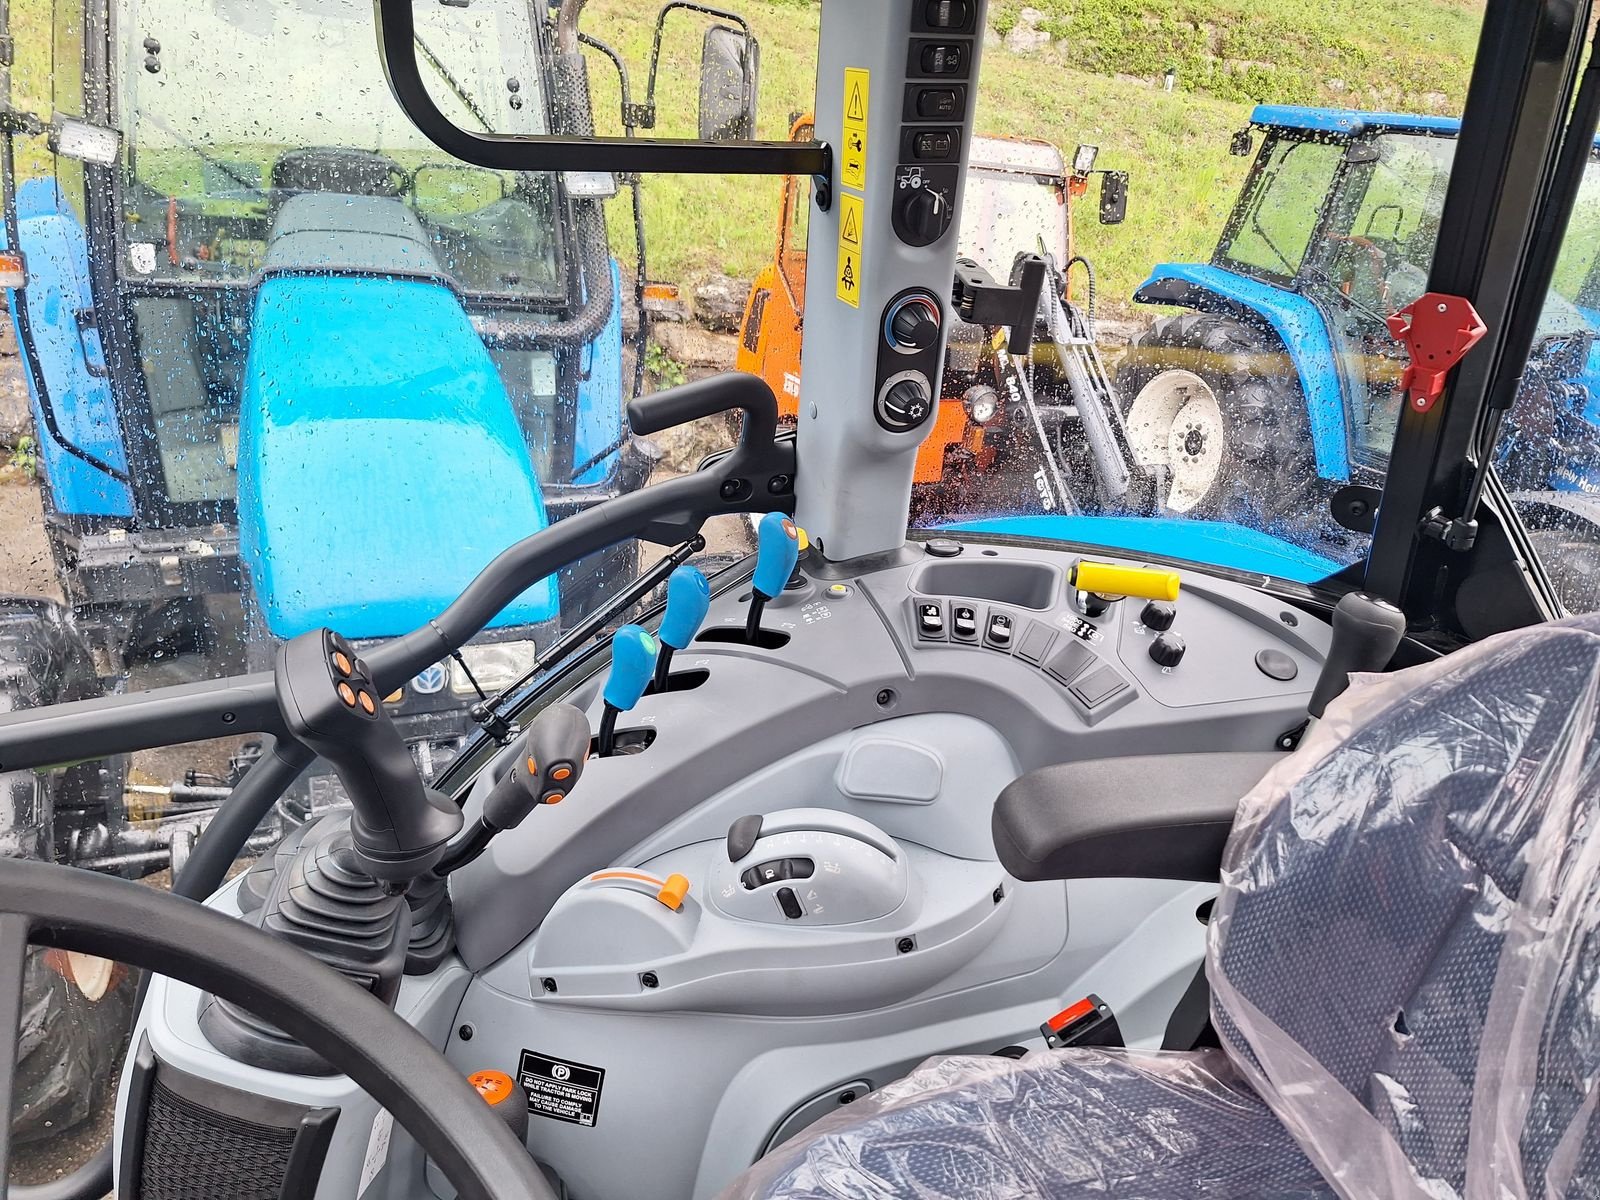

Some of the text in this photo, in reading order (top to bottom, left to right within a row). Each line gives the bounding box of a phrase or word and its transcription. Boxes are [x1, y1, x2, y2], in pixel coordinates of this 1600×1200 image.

[524, 1082, 540, 1090] WHILE
[540, 1086, 565, 1097] TRACTOR
[571, 1094, 592, 1102] MOVING
[545, 1082, 562, 1090] APPLY
[562, 1086, 577, 1094] PARK
[530, 1092, 552, 1101] FAILURE
[560, 1099, 582, 1108] COMPLY
[541, 1100, 558, 1108] CAUSE
[559, 1104, 582, 1113] DAMAGE
[554, 1108, 575, 1116] VEHICLE
